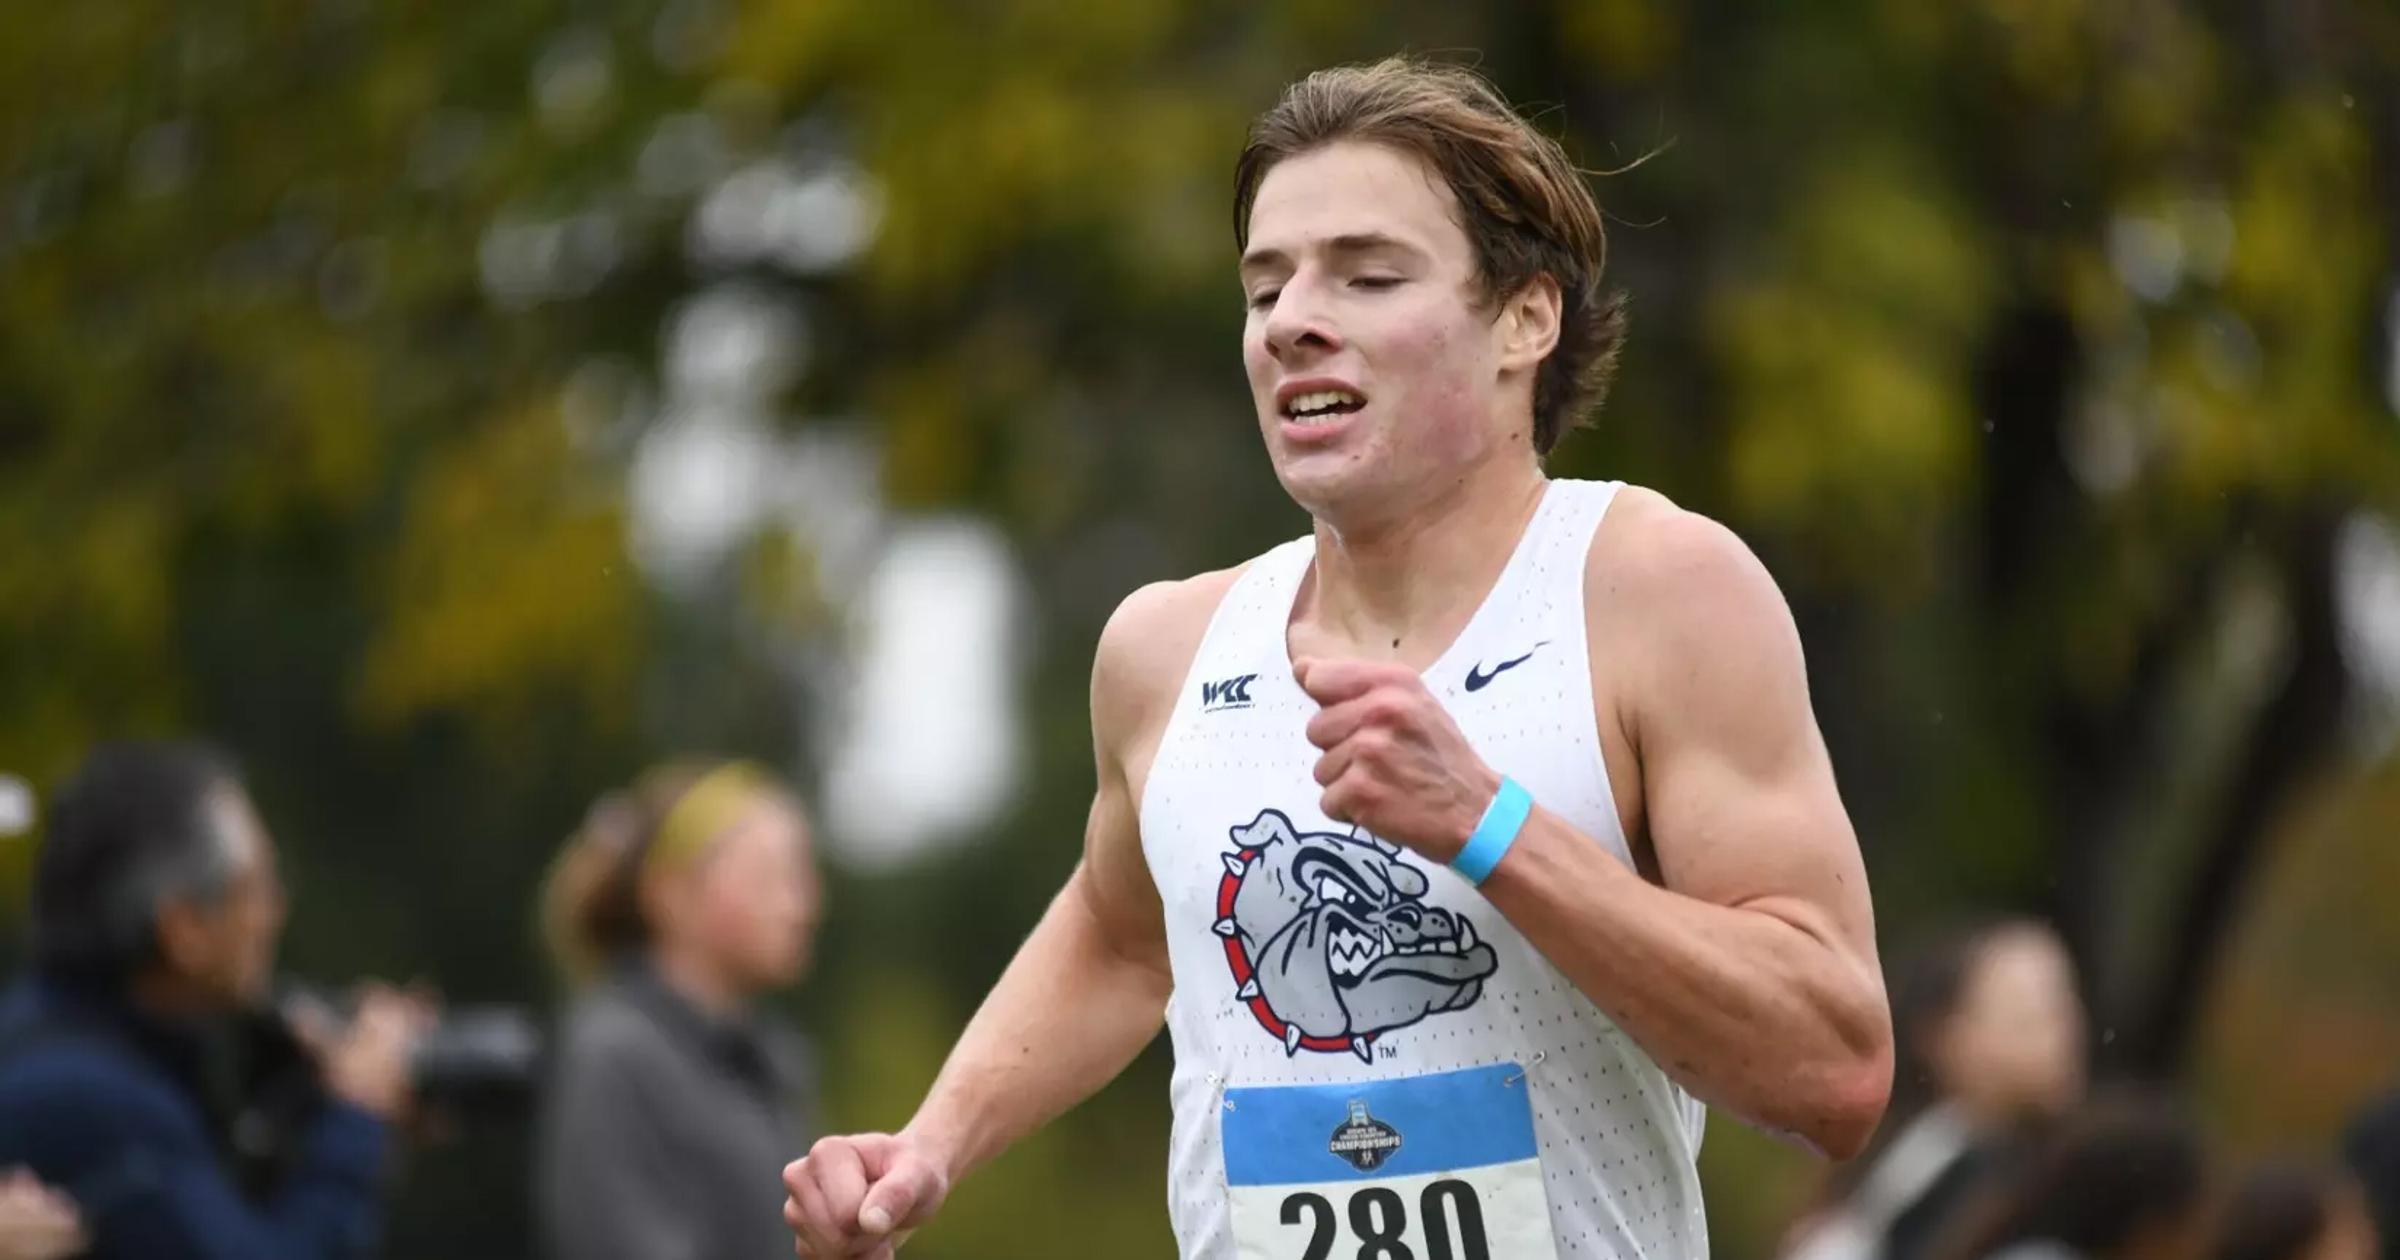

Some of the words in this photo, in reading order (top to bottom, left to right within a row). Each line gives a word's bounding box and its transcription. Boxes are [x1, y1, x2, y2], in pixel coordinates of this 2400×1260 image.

[1202, 673, 1258, 706] WCC
[1378, 1046, 1397, 1059] TM
[1331, 1136, 1400, 1152] CHAMPIONSHIPS
[1280, 1179, 1490, 1260] 280
